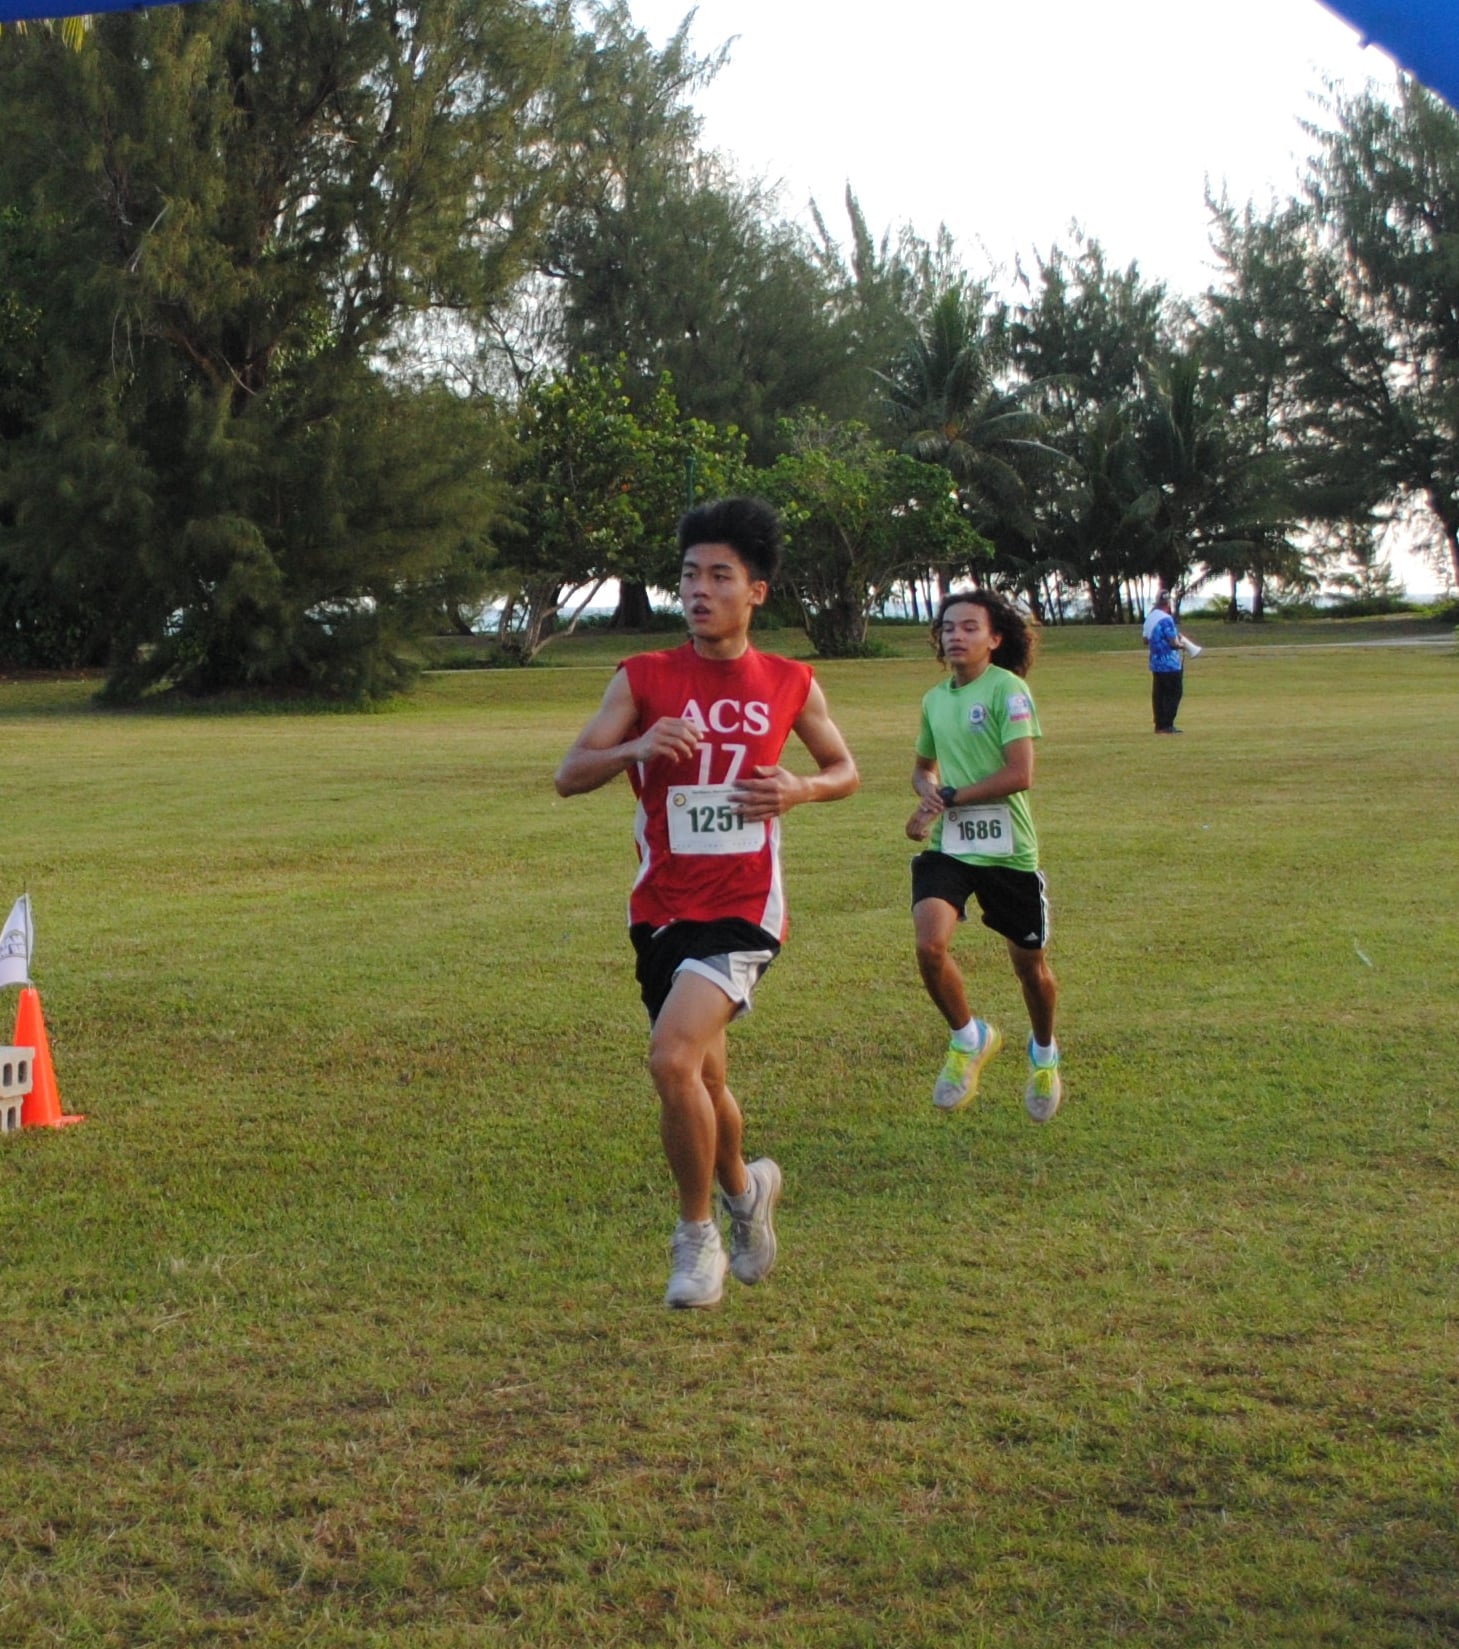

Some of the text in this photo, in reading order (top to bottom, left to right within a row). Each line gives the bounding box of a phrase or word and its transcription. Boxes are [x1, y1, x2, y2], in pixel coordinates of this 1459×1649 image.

[680, 699, 771, 736] ACS
[696, 742, 746, 785] 17
[957, 819, 1002, 841] 1686
